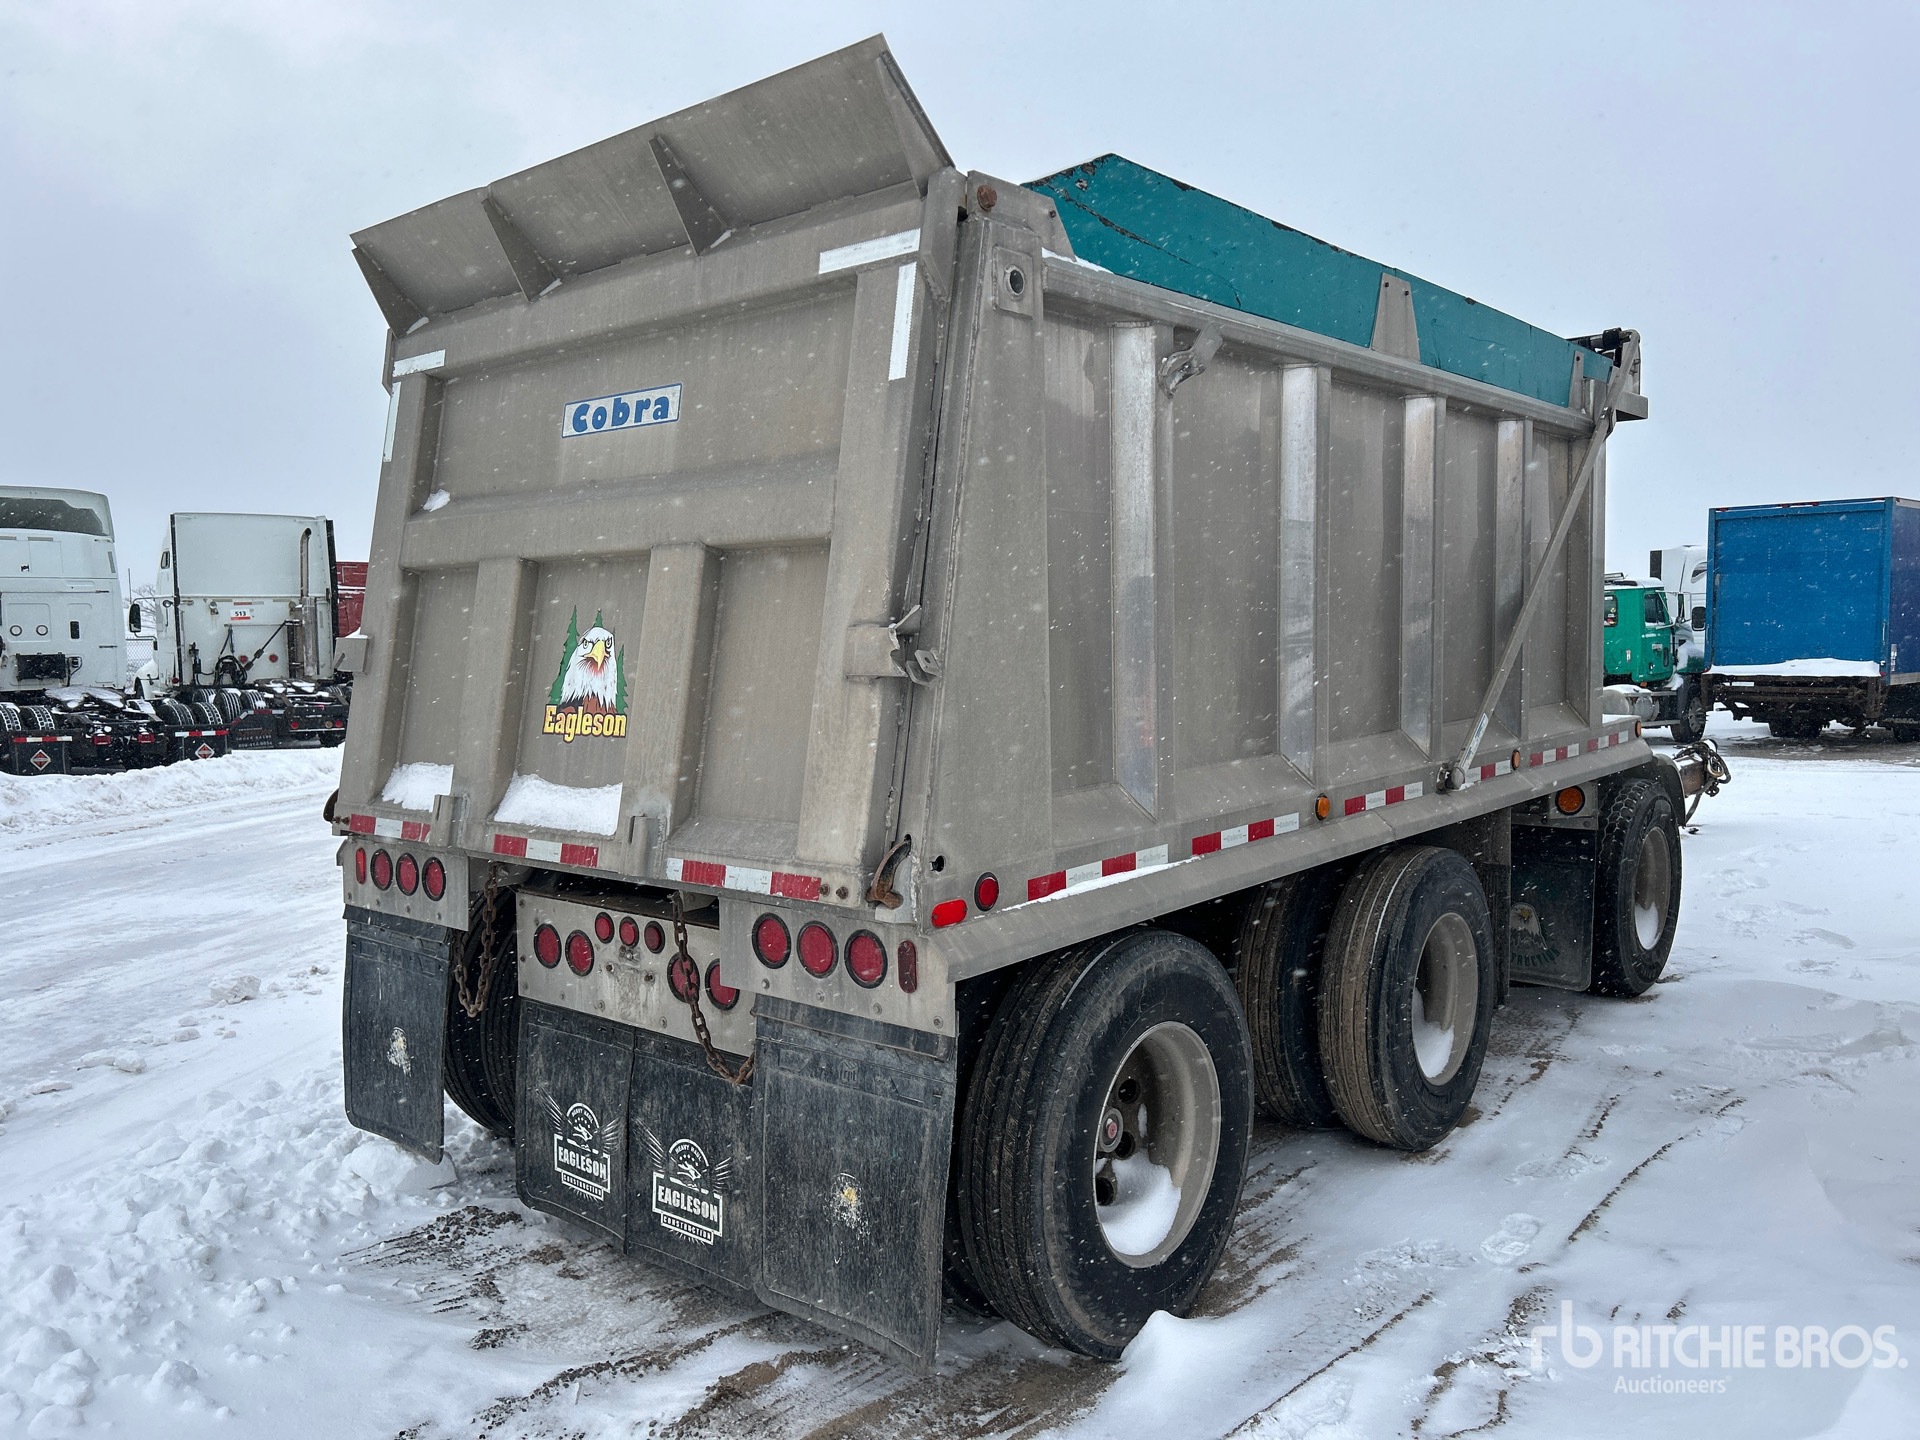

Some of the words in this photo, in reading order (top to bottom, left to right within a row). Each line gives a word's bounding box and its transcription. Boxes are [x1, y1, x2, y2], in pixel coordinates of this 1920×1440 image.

[572, 397, 669, 432] Cobra
[543, 705, 627, 743] Eagleson
[558, 1146, 607, 1180] EAGLESON
[563, 1174, 602, 1196] CONSTRUCTION
[658, 1185, 718, 1222] EAGLESON
[663, 1215, 711, 1240] CONSTRUCTION
